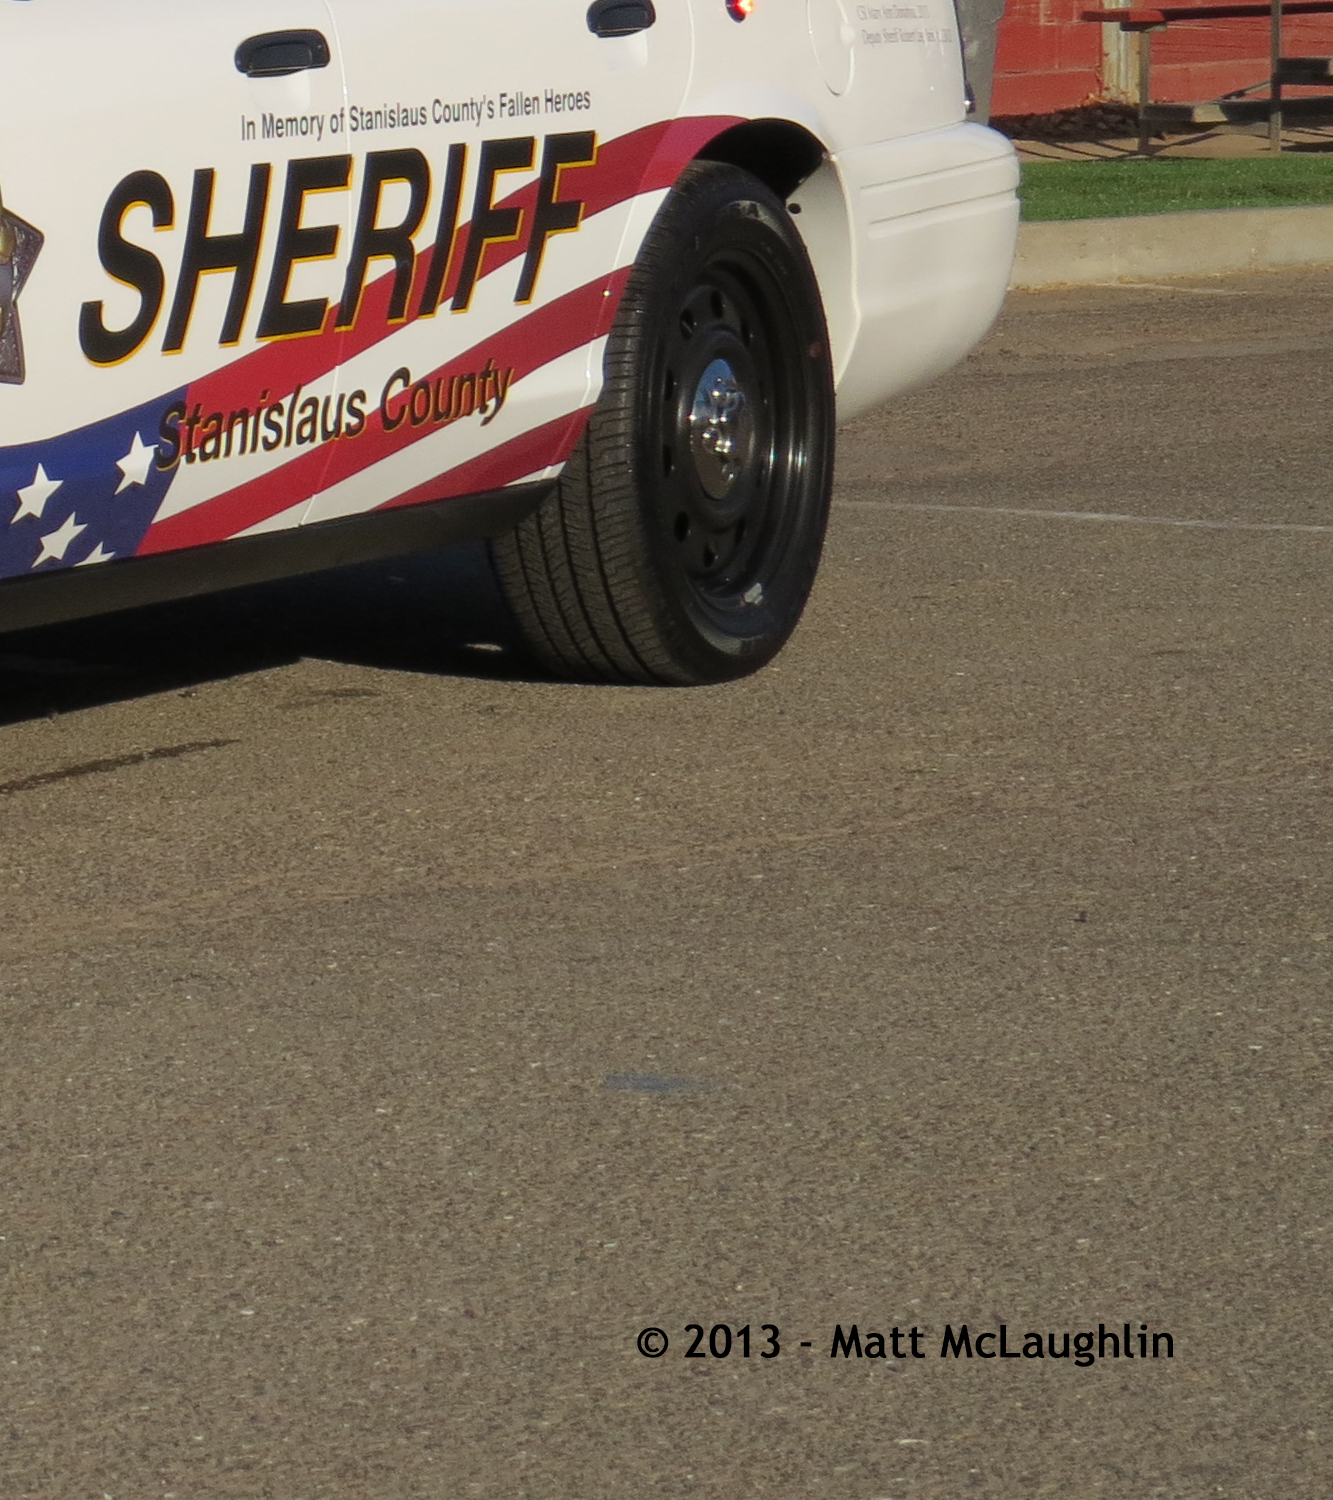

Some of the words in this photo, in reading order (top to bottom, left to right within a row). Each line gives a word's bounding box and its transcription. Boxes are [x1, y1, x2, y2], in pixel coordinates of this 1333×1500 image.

[241, 115, 256, 141] In
[261, 112, 325, 142] Memory
[330, 106, 345, 134] of
[349, 102, 428, 132] Stanislaus
[432, 94, 495, 127] County's
[499, 91, 540, 118] Fallen
[544, 88, 592, 114] Heroes
[78, 129, 600, 368] SHERIFF
[153, 383, 369, 472] Stanislaus
[380, 357, 516, 427] County
